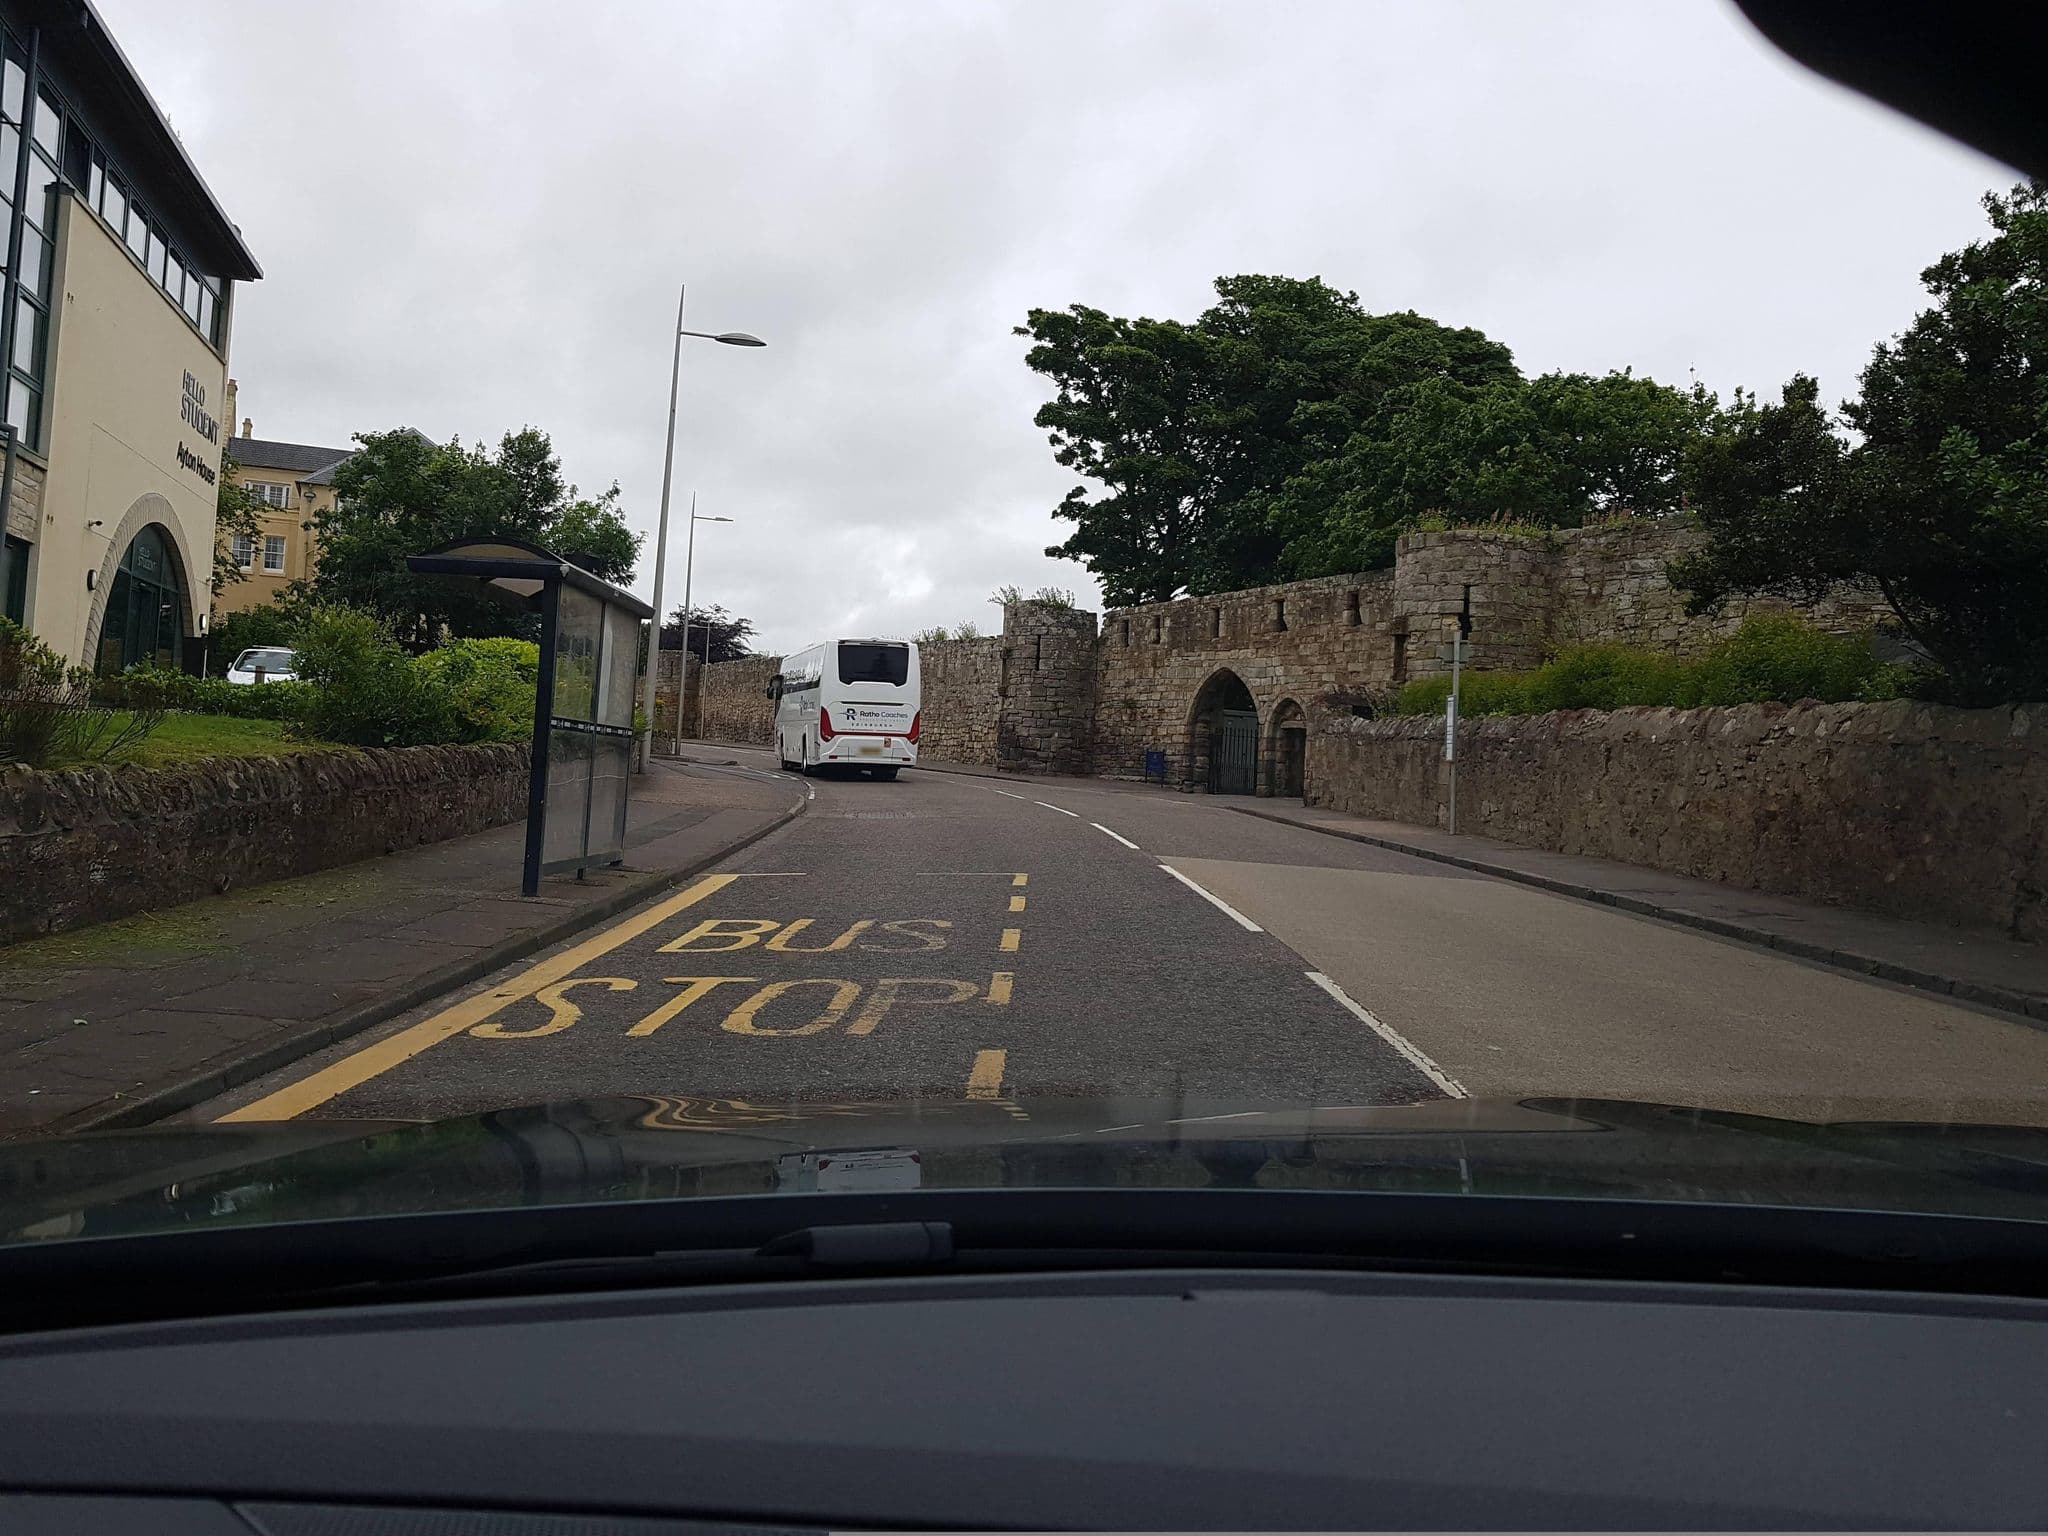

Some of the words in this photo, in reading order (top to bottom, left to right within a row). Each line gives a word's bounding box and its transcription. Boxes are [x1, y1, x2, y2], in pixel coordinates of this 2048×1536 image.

[182, 368, 206, 407] HELLO
[180, 393, 220, 446] STUDENT
[176, 440, 196, 470] Ayton
[196, 454, 216, 486] House
[881, 711, 909, 719] Coaches
[656, 918, 953, 953] BUS
[468, 976, 984, 1039] STOP
